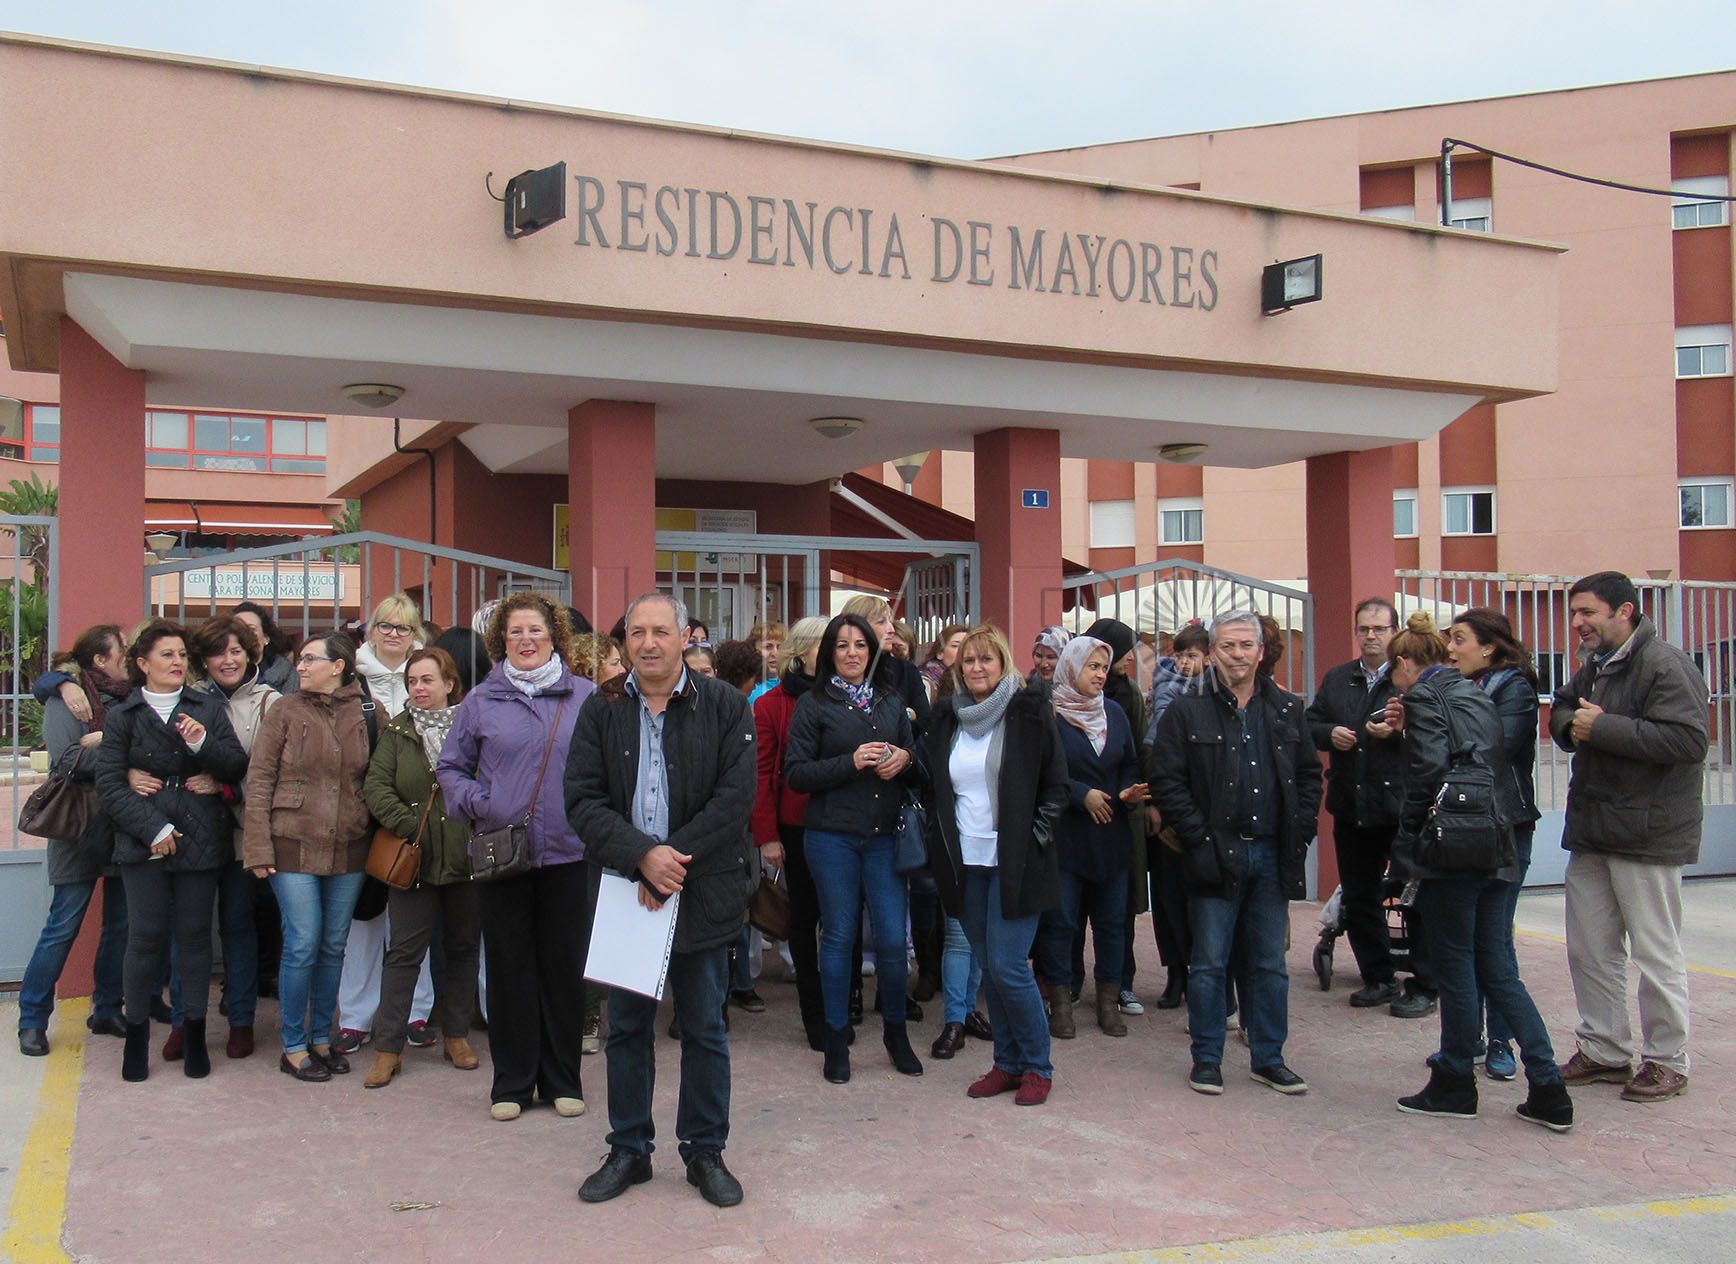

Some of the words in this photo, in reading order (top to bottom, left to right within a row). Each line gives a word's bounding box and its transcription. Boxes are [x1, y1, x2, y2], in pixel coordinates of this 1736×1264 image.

[574, 175, 911, 280] RESIDENCIA
[930, 217, 995, 287] DE
[1007, 225, 1219, 313] MAYORES
[1031, 492, 1039, 505] 1
[187, 573, 224, 584] CENTO
[226, 573, 284, 585] POLVALENE
[286, 574, 296, 585] DE
[298, 574, 339, 586] SRVICIO
[235, 585, 276, 596] PESONA
